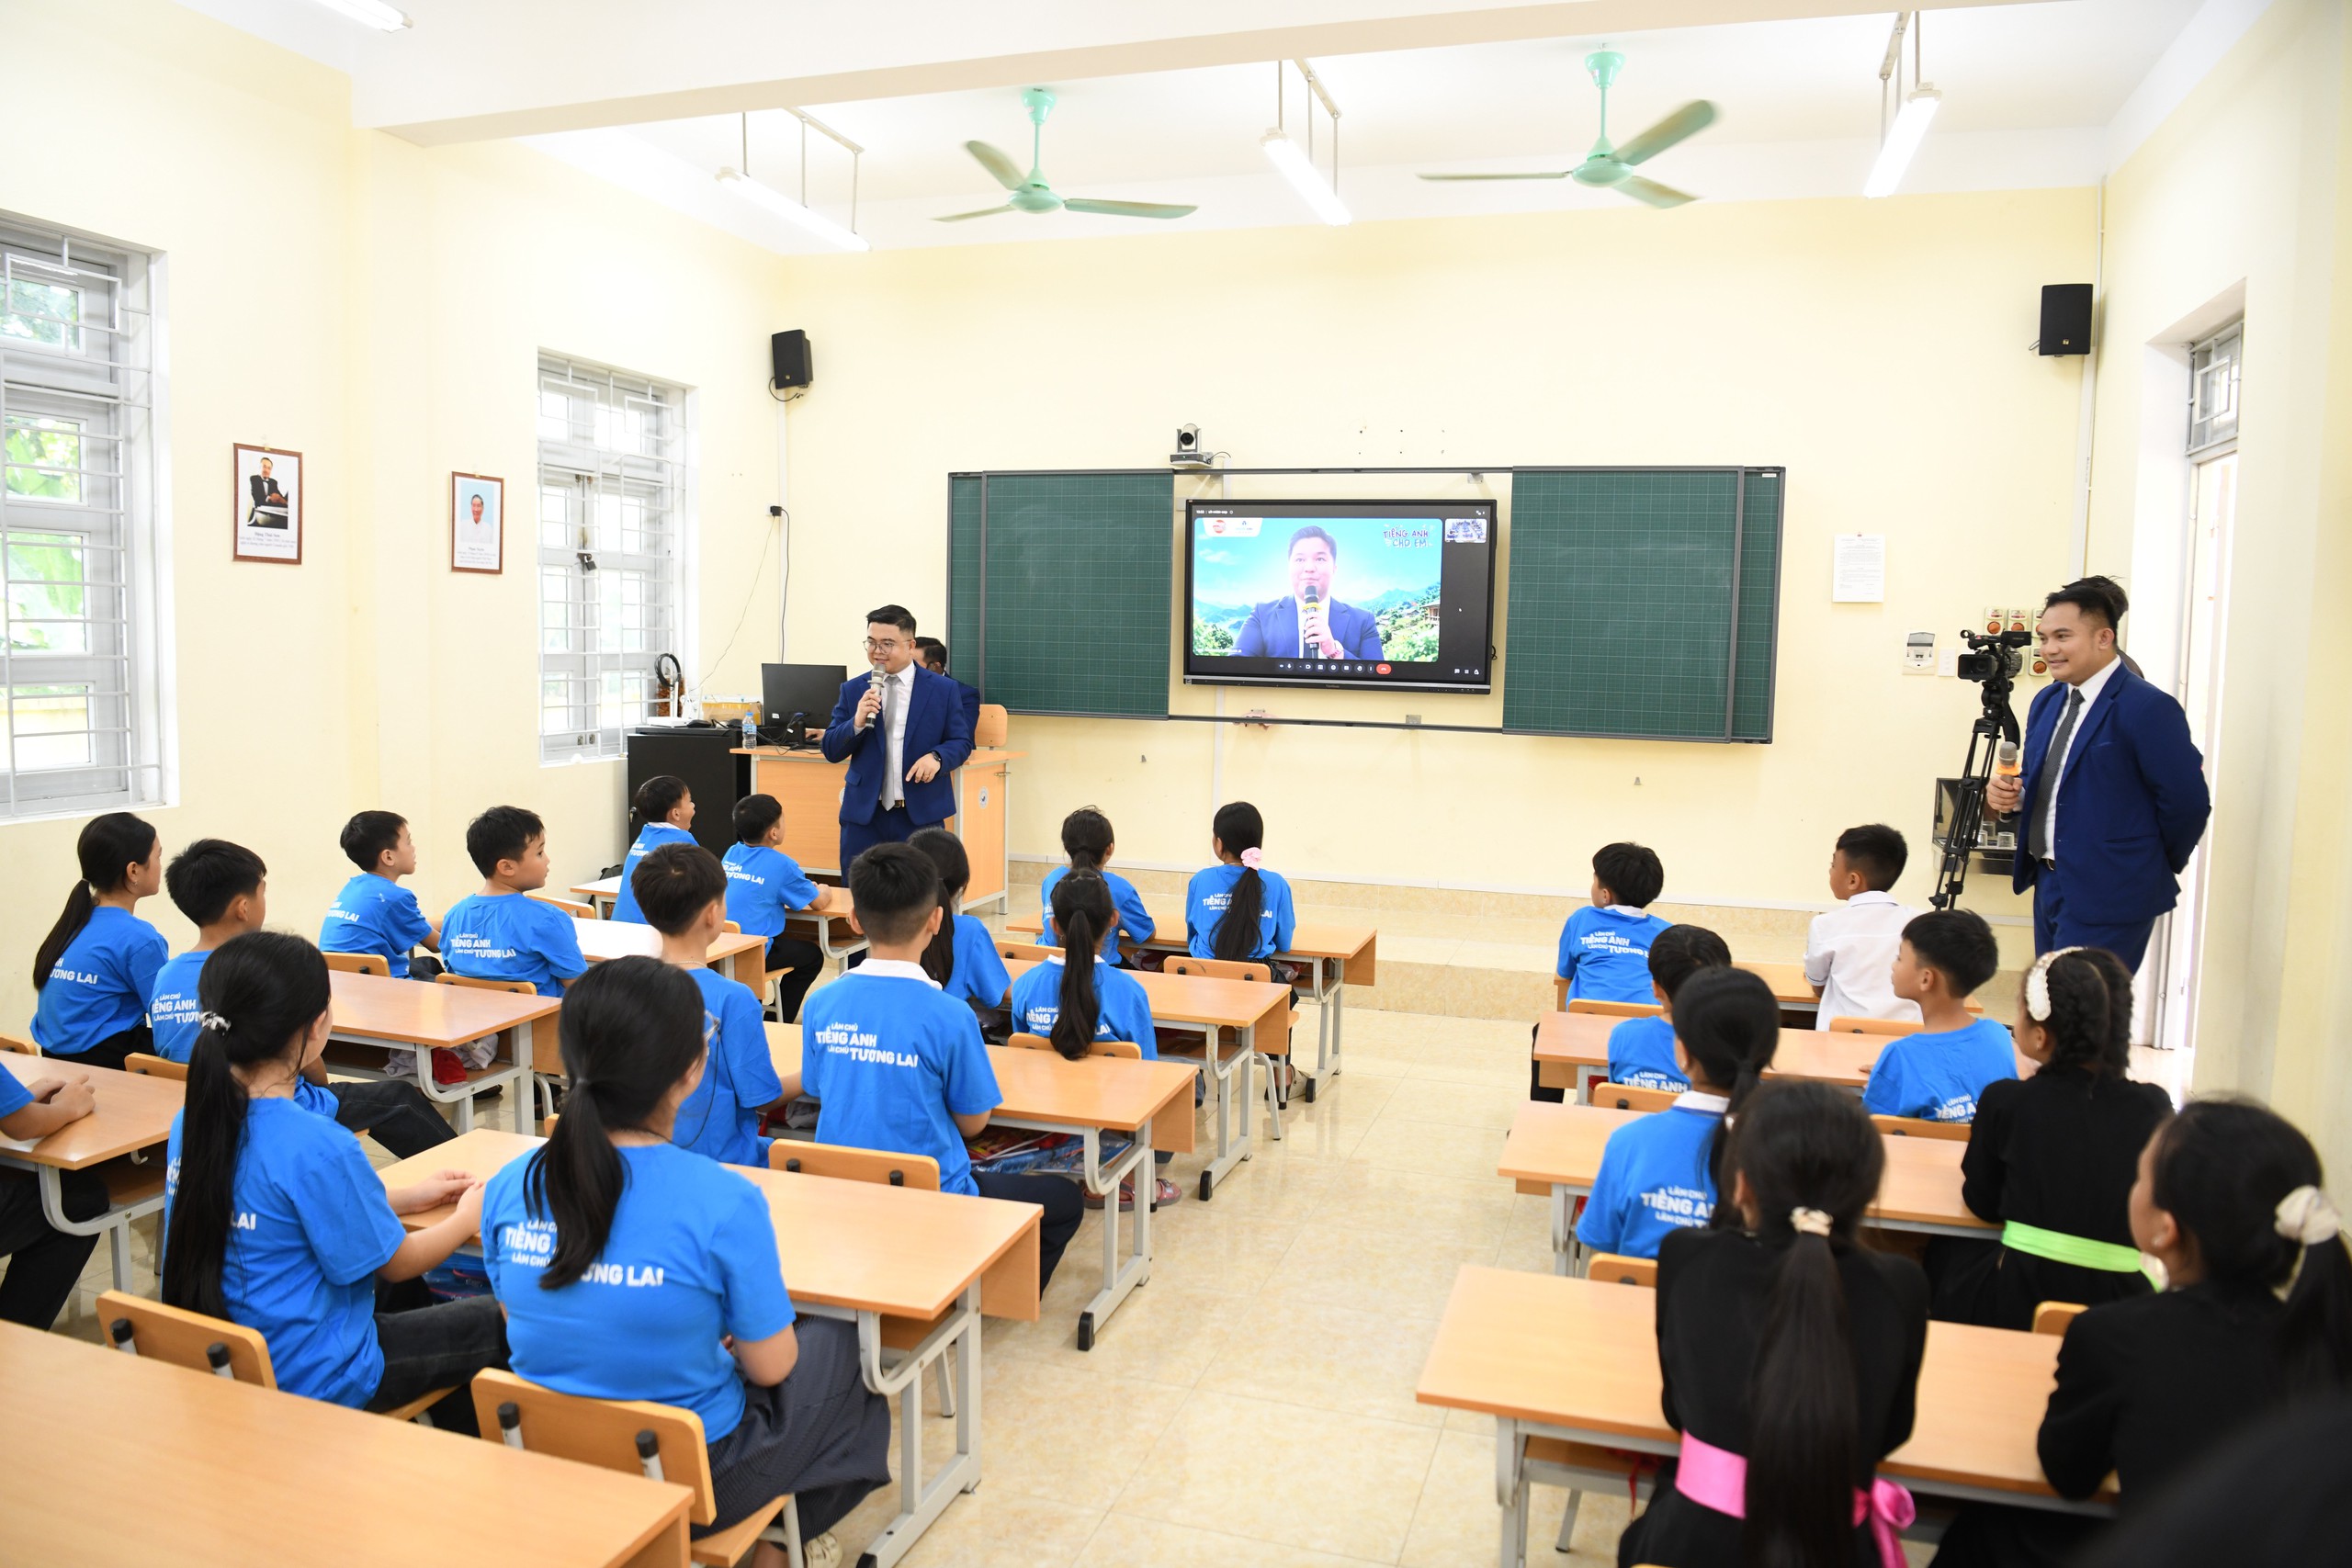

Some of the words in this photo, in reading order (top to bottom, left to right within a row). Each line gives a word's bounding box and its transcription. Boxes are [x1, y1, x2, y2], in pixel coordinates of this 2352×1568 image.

[1411, 529, 1429, 537] ANH
[1393, 538, 1410, 547] CHO
[1414, 538, 1427, 547] EM
[751, 874, 765, 886] LAI
[1202, 895, 1227, 907] TIẾNG
[344, 911, 360, 922] LAI
[472, 939, 492, 948] ANH
[1580, 933, 1608, 945] TIẾNG
[1608, 936, 1630, 946] ANH
[474, 949, 502, 958] TƯƠNG
[502, 948, 516, 958] LAI
[1608, 945, 1644, 955] TƯƠNG
[76, 972, 98, 985] LAI
[174, 998, 197, 1011] ANH
[831, 1021, 844, 1031] LÀM
[844, 1022, 858, 1032] CHỦ
[815, 1026, 849, 1044] TIẾNG
[849, 1033, 877, 1047] ANH
[835, 1045, 849, 1055] CHỦ
[849, 1047, 895, 1065] TƯƠNG
[896, 1053, 919, 1067] LAI
[1623, 1073, 1657, 1090] TIẾNG
[1658, 1080, 1688, 1093] ANH
[1667, 1185, 1689, 1198] LÀM
[1639, 1187, 1693, 1215] TIẾNG
[1655, 1210, 1675, 1224] LÀM
[526, 1219, 548, 1232] LÀM
[505, 1222, 551, 1253] TIẾNG
[512, 1251, 530, 1265] LÀM
[627, 1265, 664, 1287] LAI
